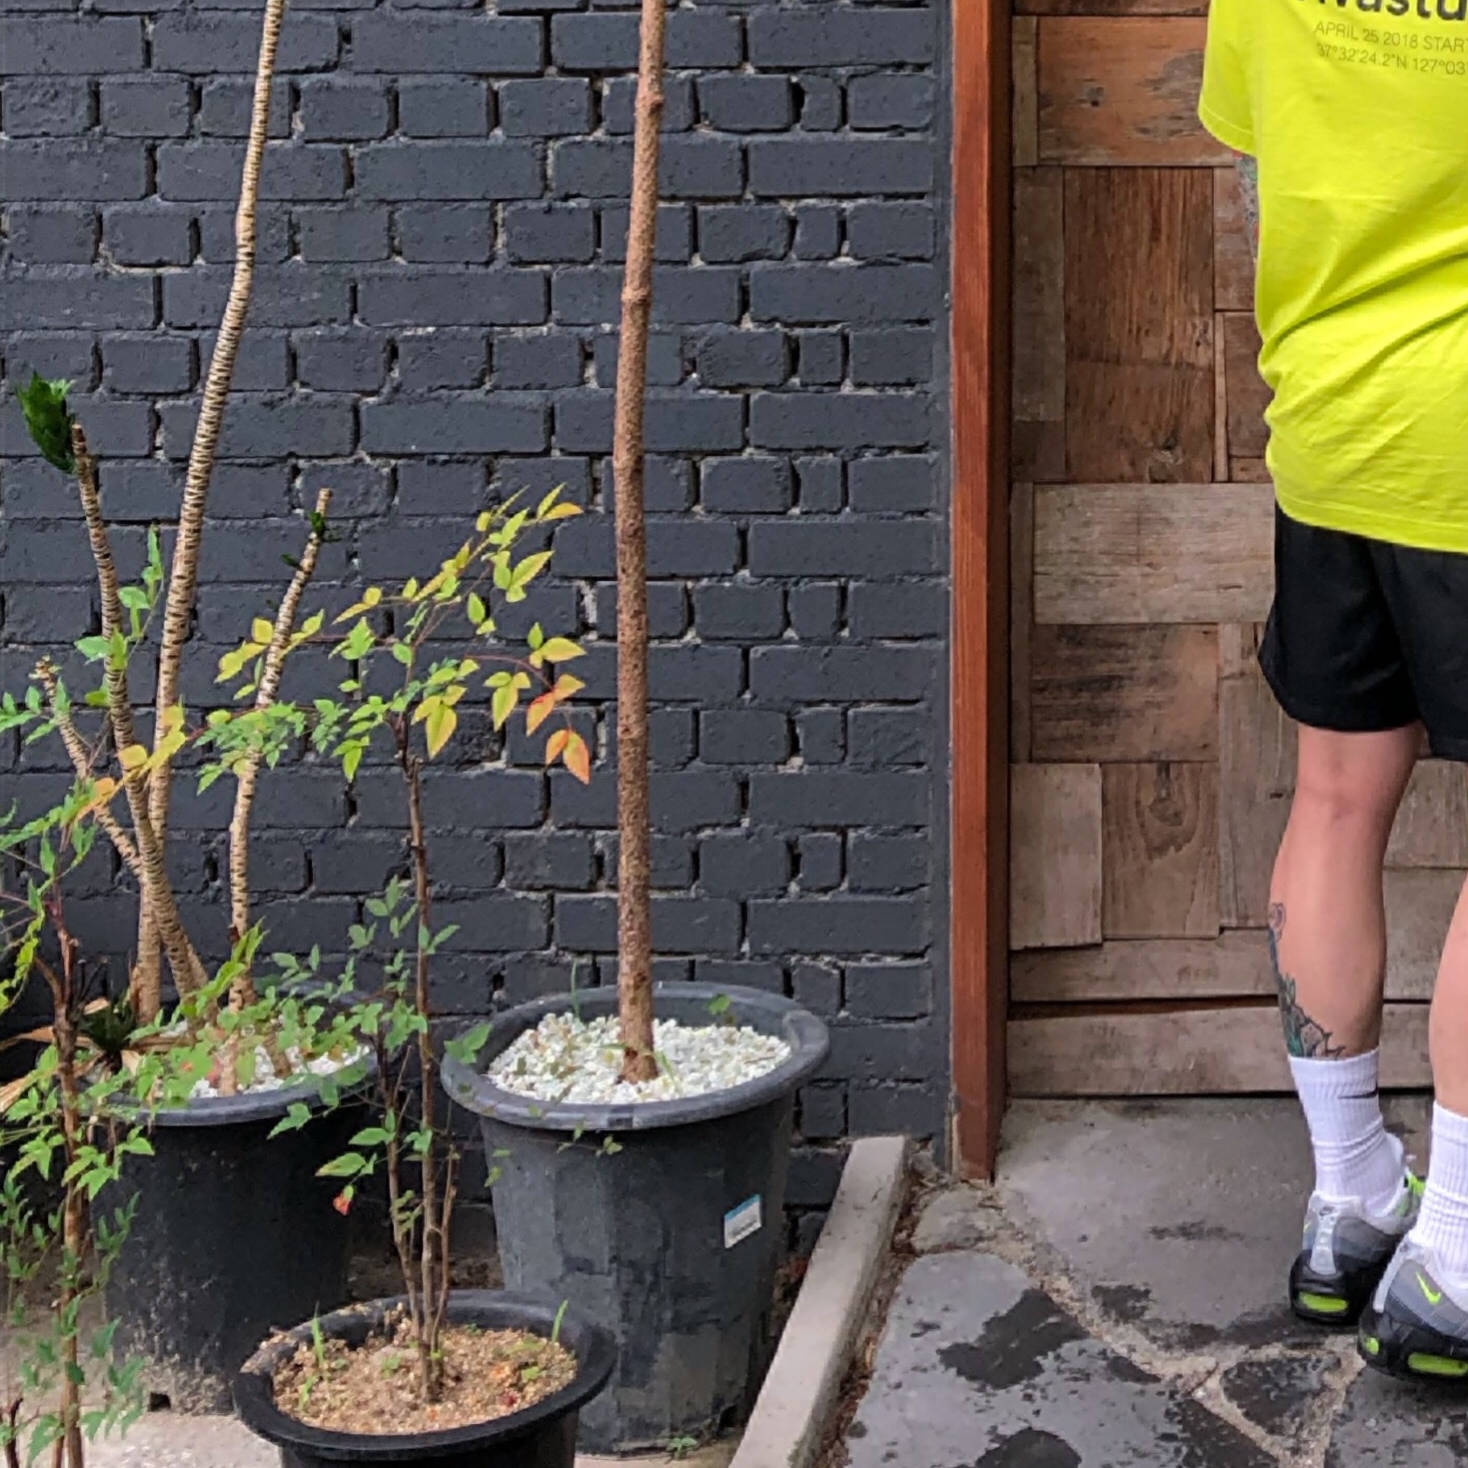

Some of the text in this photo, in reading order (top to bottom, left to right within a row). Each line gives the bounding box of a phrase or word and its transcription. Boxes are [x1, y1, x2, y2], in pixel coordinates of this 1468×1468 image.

[1314, 20, 1359, 41] APRIL
[1362, 28, 1380, 44] 25
[1383, 31, 1419, 49] 2018
